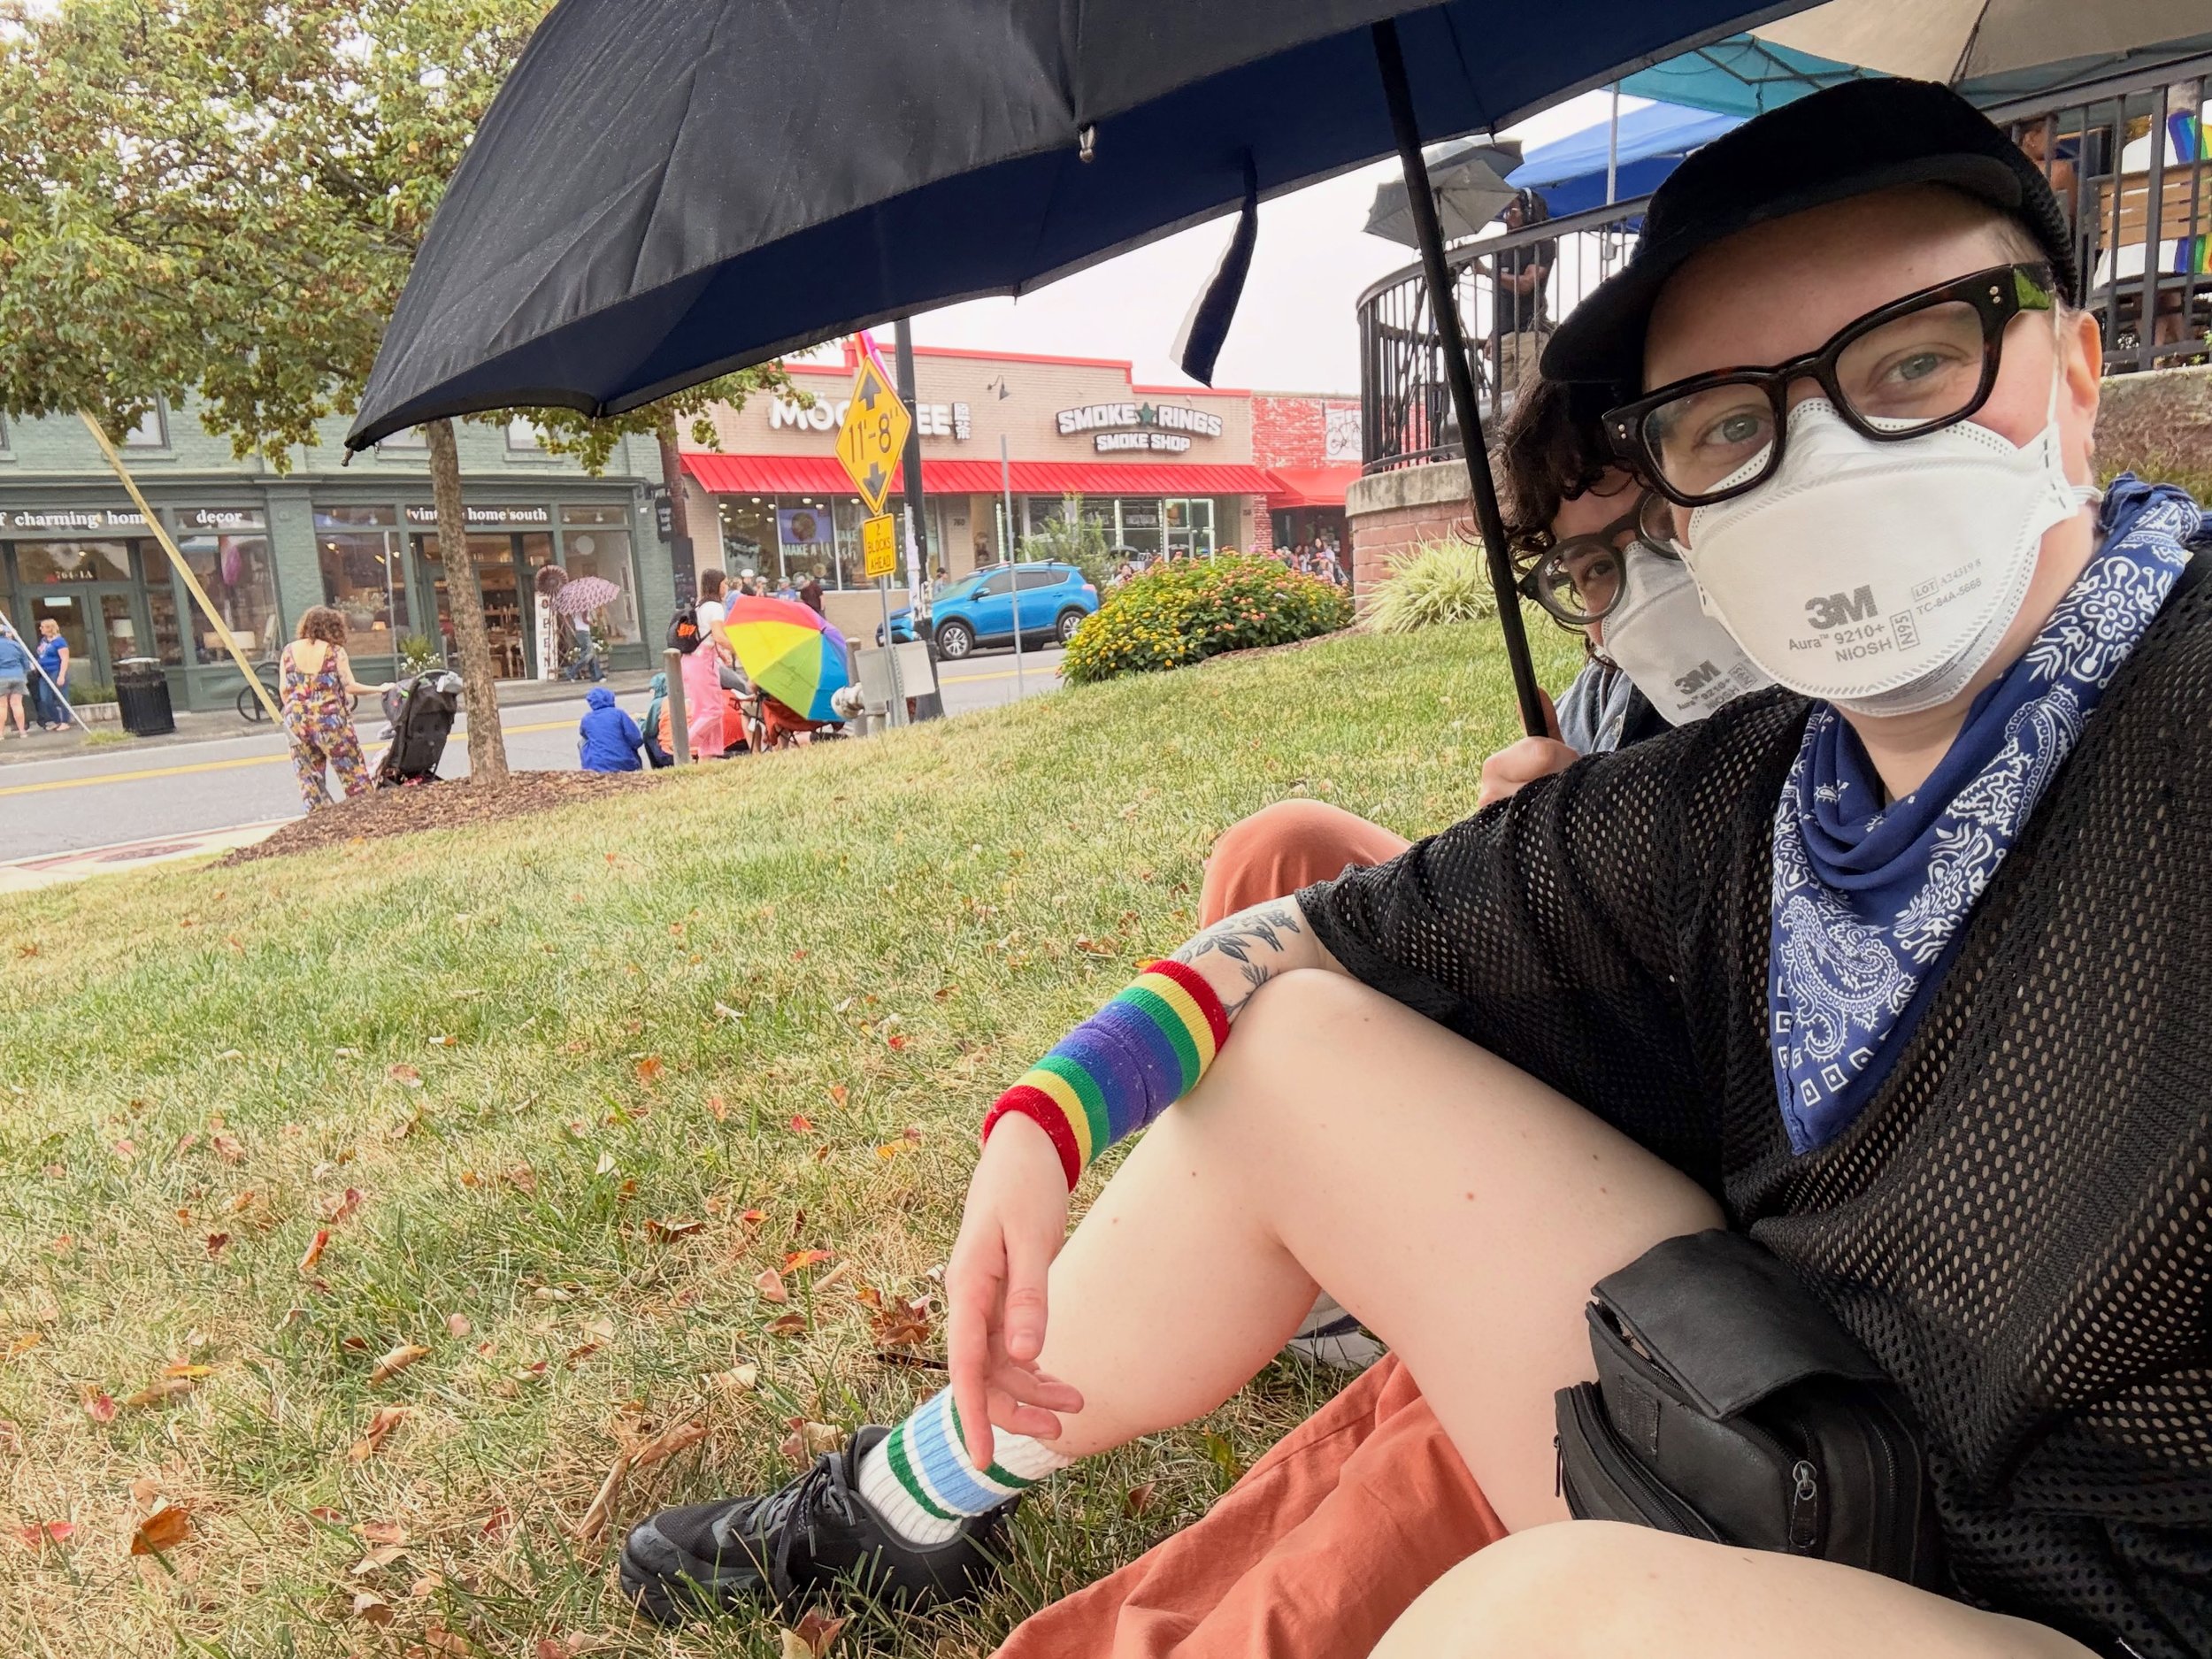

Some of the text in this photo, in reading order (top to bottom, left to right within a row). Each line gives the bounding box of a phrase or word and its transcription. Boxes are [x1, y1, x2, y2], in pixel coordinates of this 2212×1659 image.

[770, 391, 951, 435] MÖ EE
[1057, 403, 1223, 437] SMOKE RINGS
[1095, 433, 1191, 452] SMOKE SHOP
[14, 511, 100, 529] charming
[106, 510, 148, 525] hom
[196, 509, 243, 524] decor
[467, 507, 507, 521] home
[508, 508, 548, 521] south
[876, 523, 881, 535] 2
[782, 543, 809, 557] MAKE
[818, 536, 858, 562] Wsh
[868, 537, 891, 554] BLOCKS
[871, 556, 891, 571] AHEAD
[1916, 580, 1936, 597] LOT
[1805, 584, 1878, 630] 3M
[1833, 623, 1886, 646] 9210+
[1893, 615, 1916, 646] N95
[1834, 636, 1893, 664] NIOSH
[1674, 659, 1722, 695] 3M
